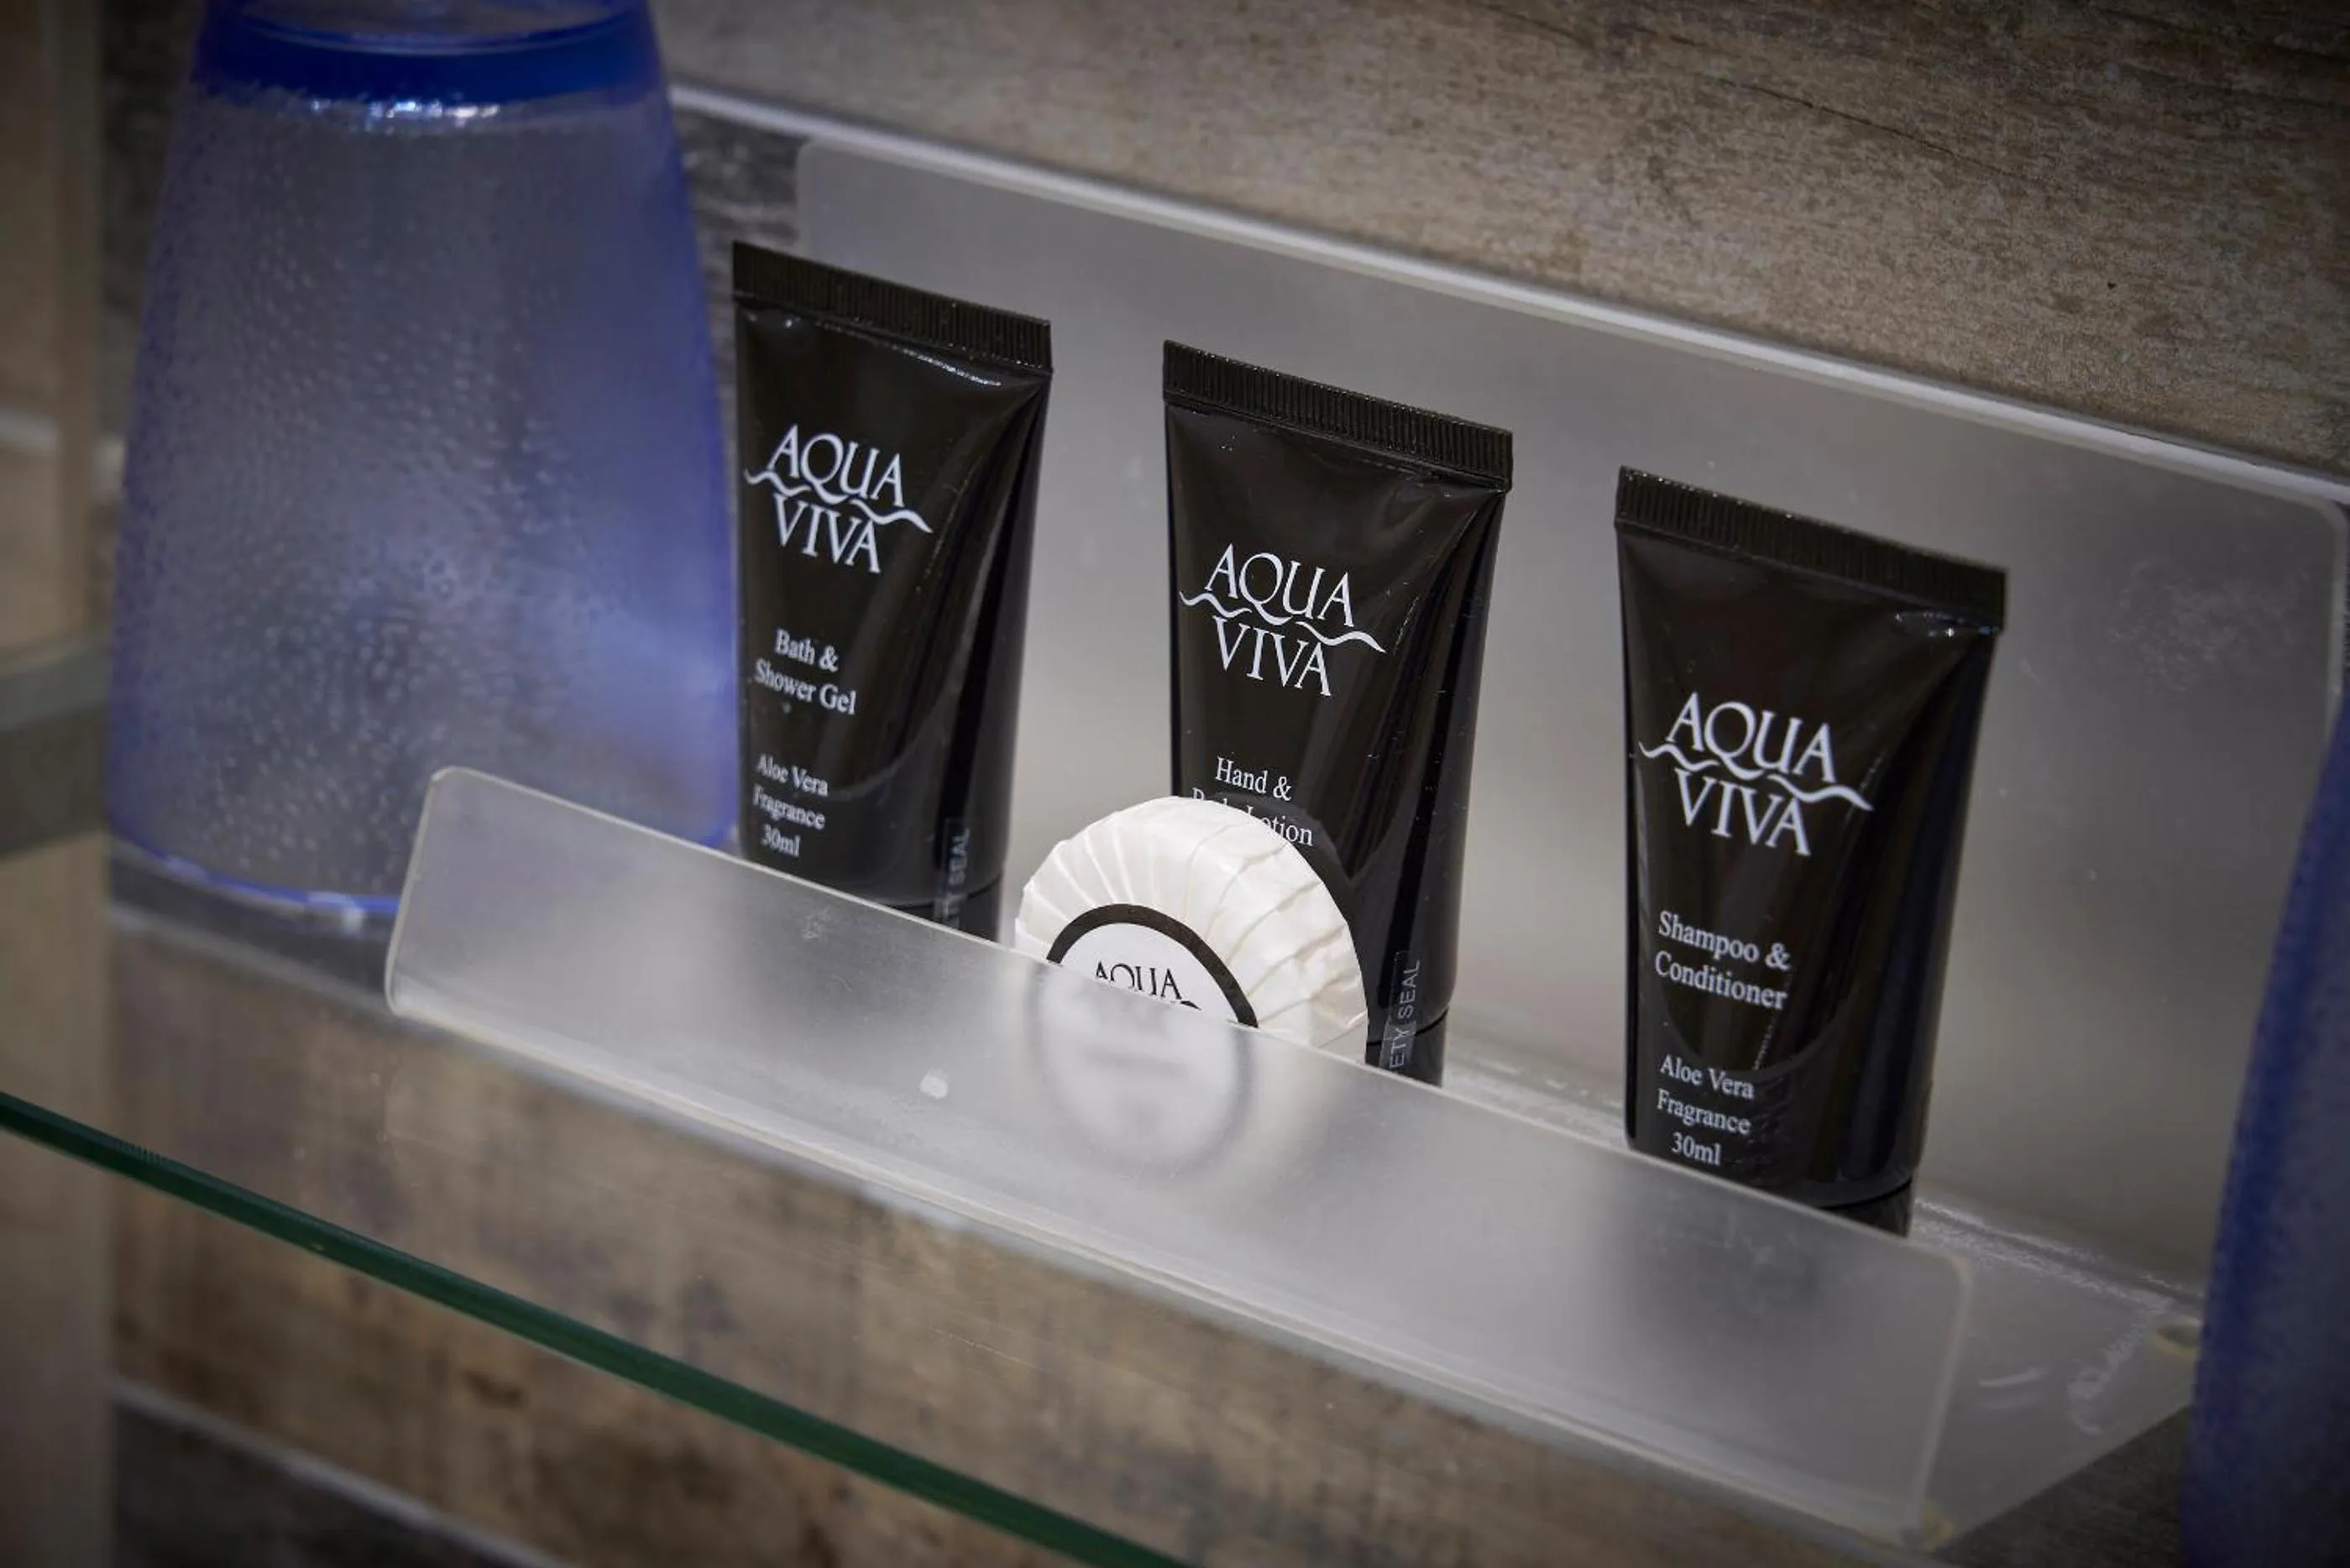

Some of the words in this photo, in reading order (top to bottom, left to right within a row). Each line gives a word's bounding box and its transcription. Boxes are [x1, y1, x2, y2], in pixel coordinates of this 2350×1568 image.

[767, 423, 904, 508] AQUA
[772, 492, 881, 573] VIVA
[1204, 543, 1354, 628] AQUA
[775, 628, 815, 666] Bath
[819, 645, 839, 672] &
[1212, 614, 1332, 697] VIVA
[755, 657, 817, 703] Shower
[819, 682, 856, 716] Gel
[1666, 690, 1837, 784] AQUA
[756, 753, 788, 784] Aloe
[791, 765, 829, 797] Vera
[1215, 755, 1269, 795] Hand
[1273, 775, 1292, 802] &
[753, 782, 825, 830] Fragrance
[1675, 766, 1811, 856] VIVA
[761, 823, 800, 857] 30ml
[1658, 909, 1760, 963] Shampoo
[1765, 941, 1792, 971] &
[1397, 959, 1421, 1020] SEAL
[1655, 949, 1789, 1011] Conditioner
[1659, 1053, 1704, 1086] Aloe
[1708, 1067, 1755, 1100] Vera
[1657, 1088, 1752, 1136] Fragrance
[1671, 1132, 1722, 1167] 30ml
